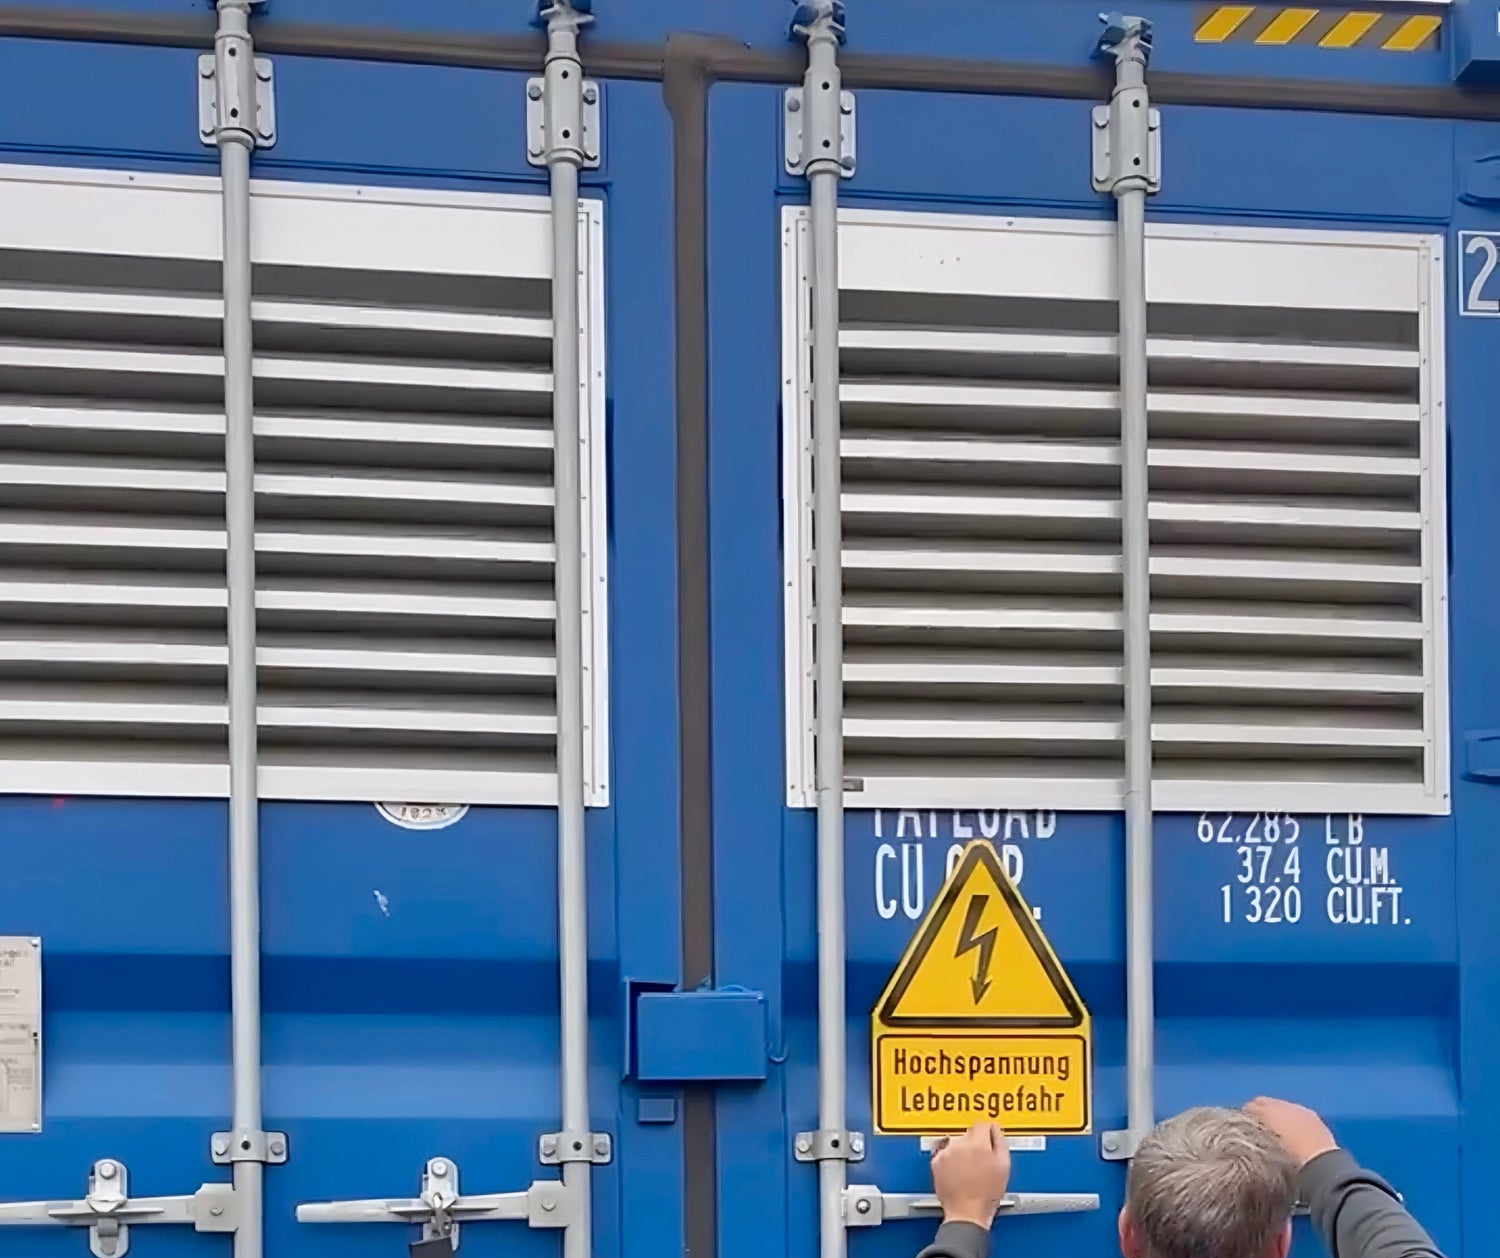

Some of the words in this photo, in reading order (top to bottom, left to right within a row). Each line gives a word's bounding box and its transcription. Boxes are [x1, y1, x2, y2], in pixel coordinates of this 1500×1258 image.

[1197, 812, 1300, 843] 62.285
[1237, 846, 1300, 883] 37.4
[1326, 847, 1396, 884] CU.M.
[1326, 886, 1411, 924] CU.FT.
[894, 1048, 1070, 1081] Hochspannung
[901, 1085, 1065, 1118] Lebensgefahr
